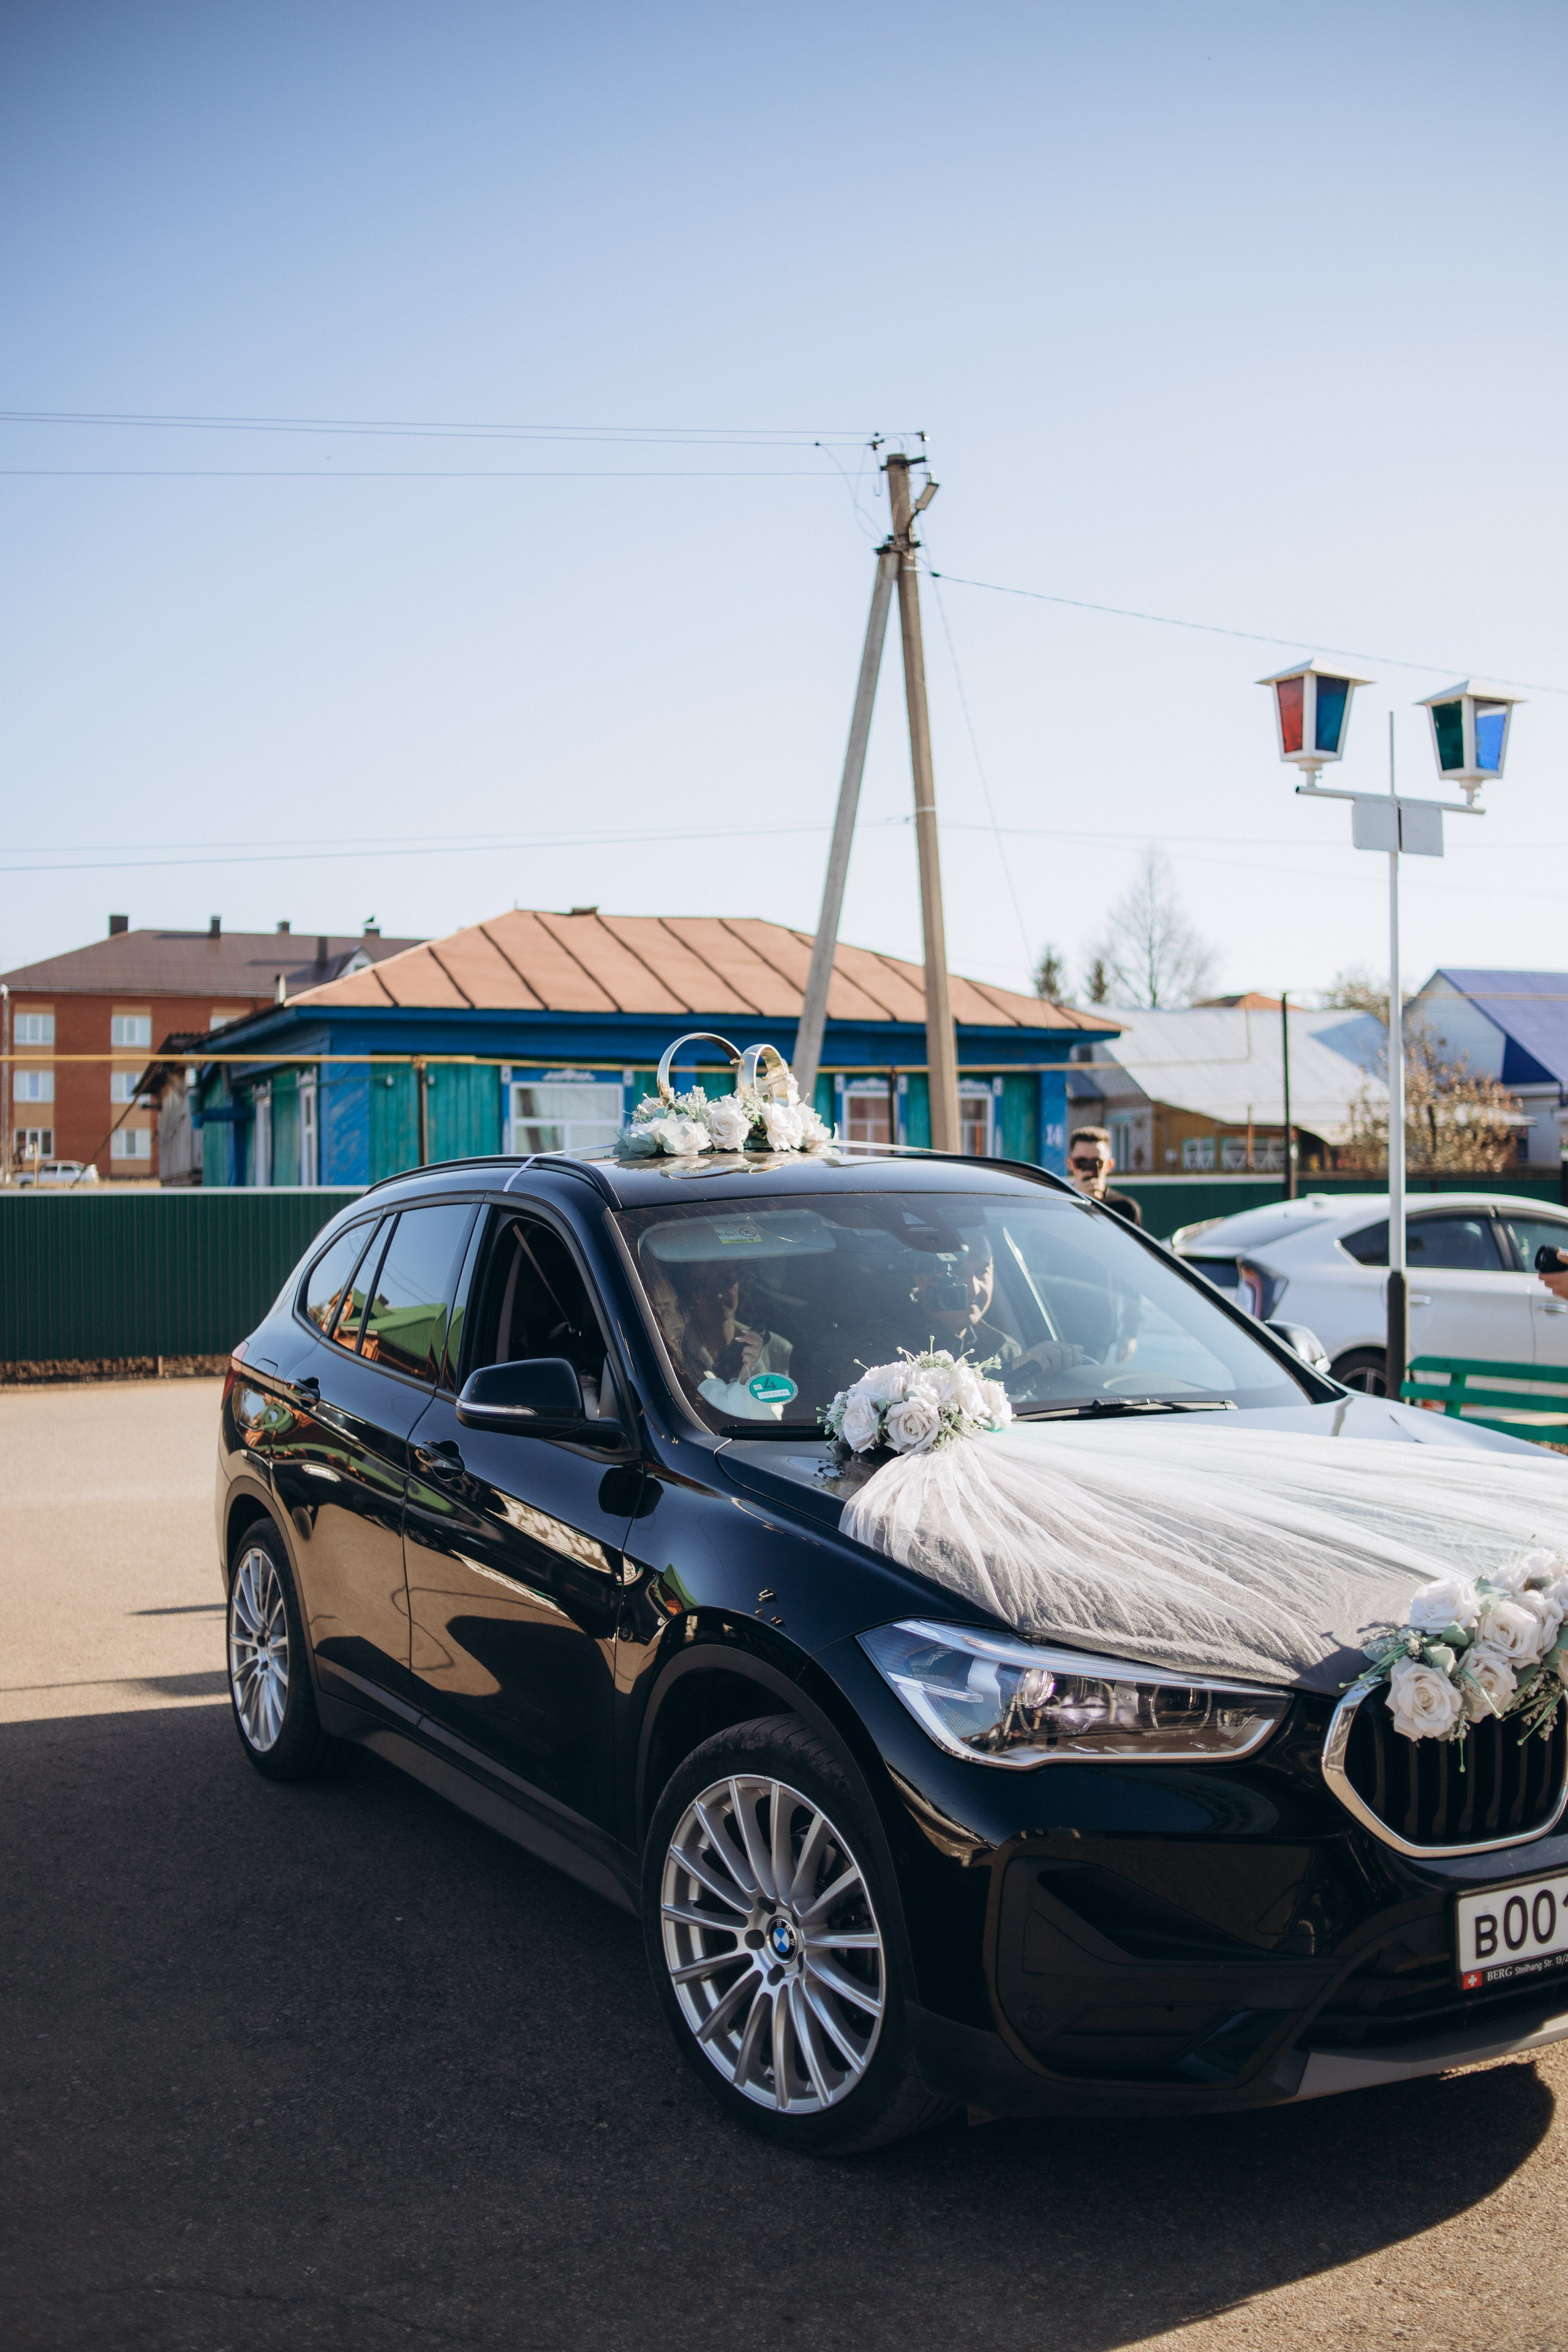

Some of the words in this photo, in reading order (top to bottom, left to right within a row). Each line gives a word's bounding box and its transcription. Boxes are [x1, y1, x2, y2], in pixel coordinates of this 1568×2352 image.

[764, 1377, 777, 1389] 4
[776, 1920, 795, 1946] BMW
[1475, 1889, 1568, 1959] B00
[1487, 1966, 1513, 1981] BERG
[1515, 1962, 1542, 1975] Steilhang
[1544, 1959, 1554, 1968] Str.
